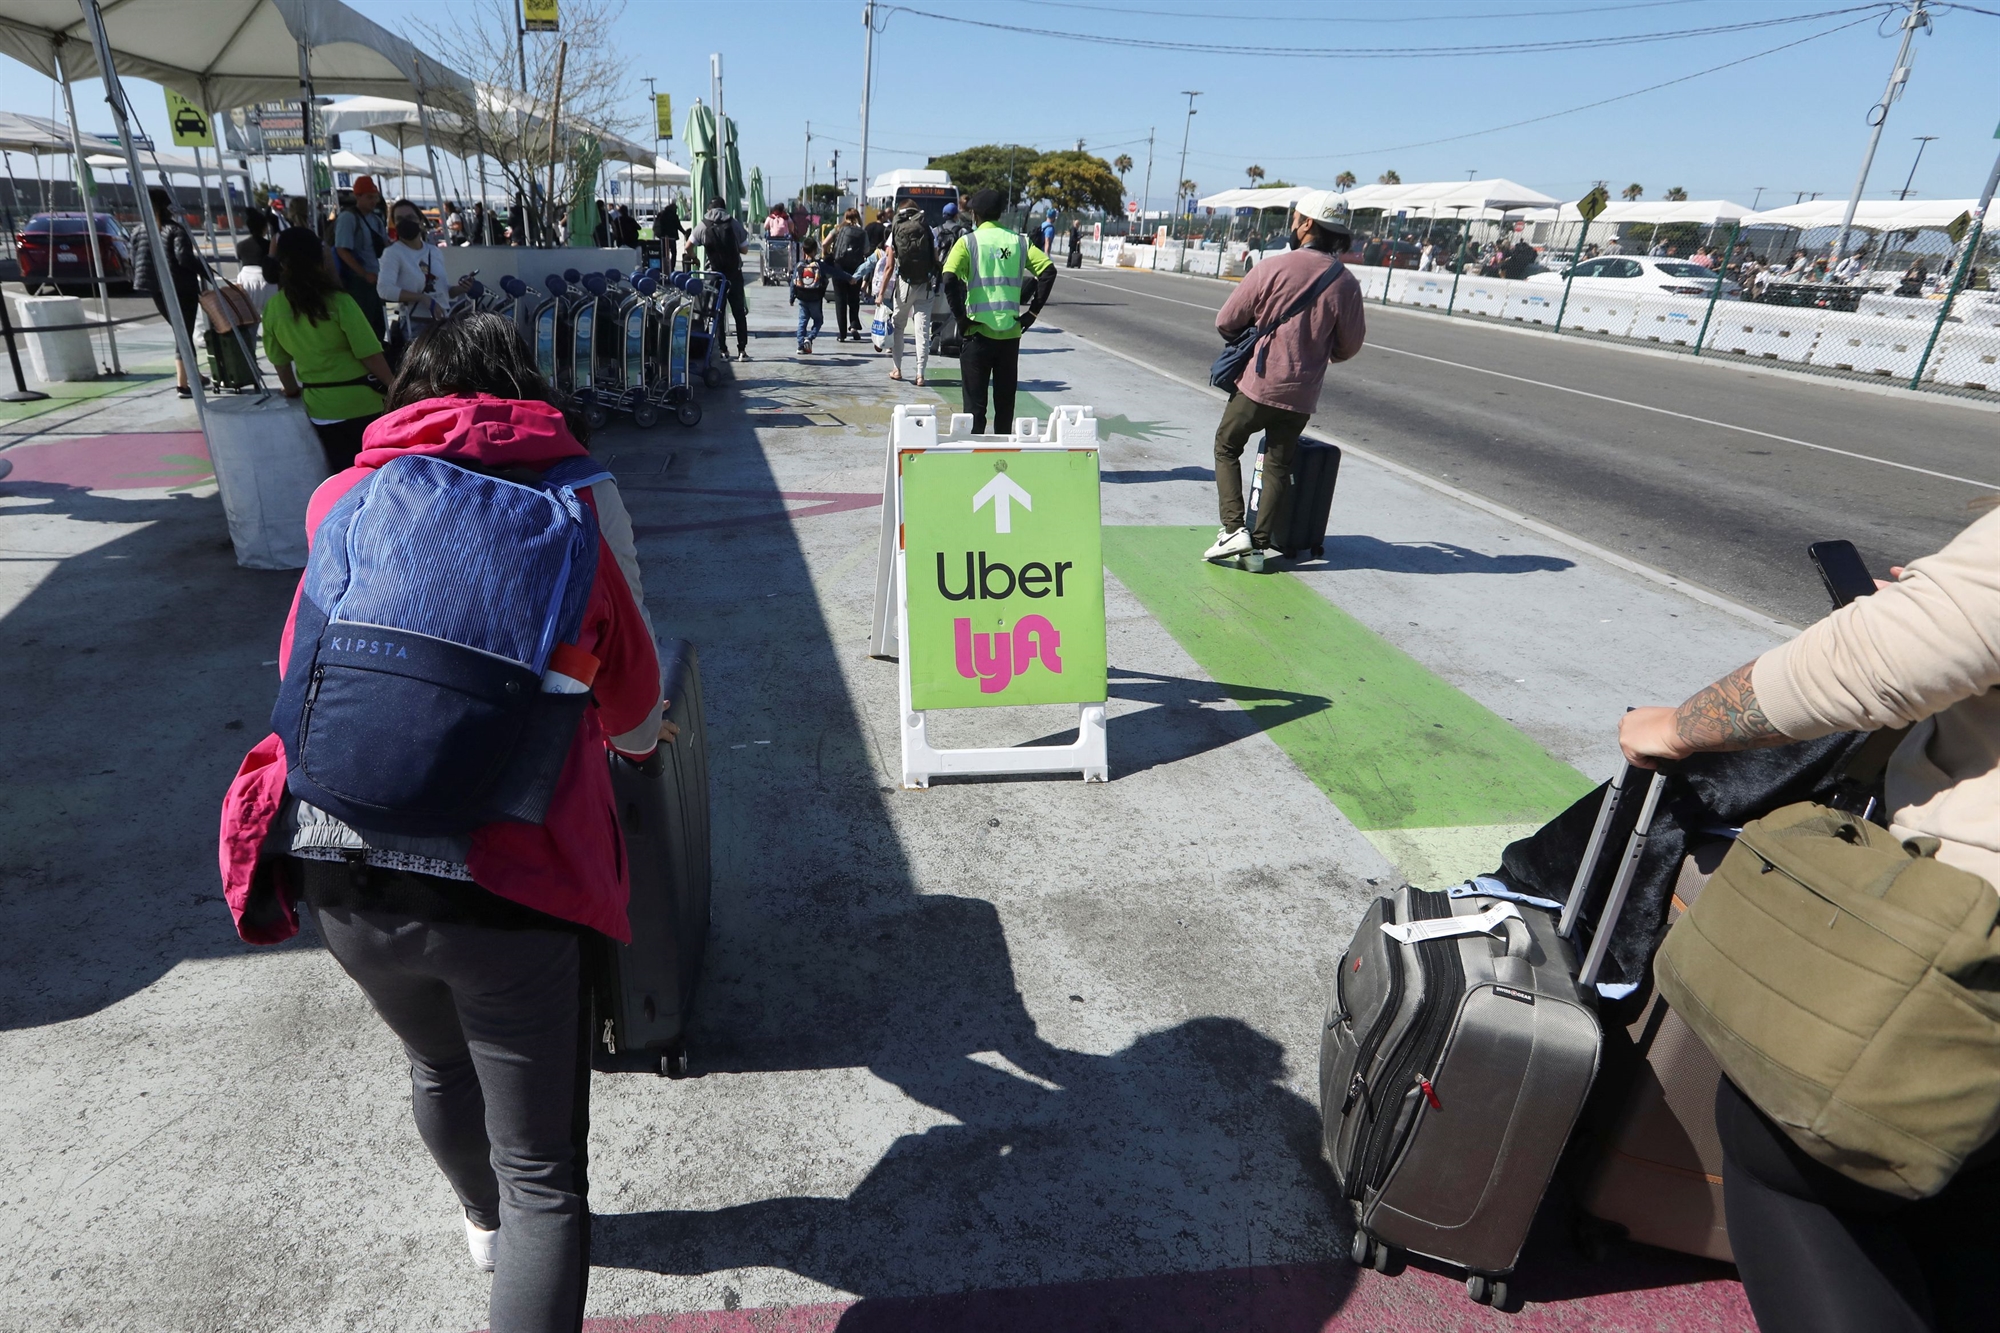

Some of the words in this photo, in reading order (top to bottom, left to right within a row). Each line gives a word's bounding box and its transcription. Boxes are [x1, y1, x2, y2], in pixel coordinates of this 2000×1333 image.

[173, 96, 191, 104] TA
[936, 551, 1072, 601] Uber
[330, 637, 407, 658] KIPSTA
[953, 613, 1062, 694] lyft
